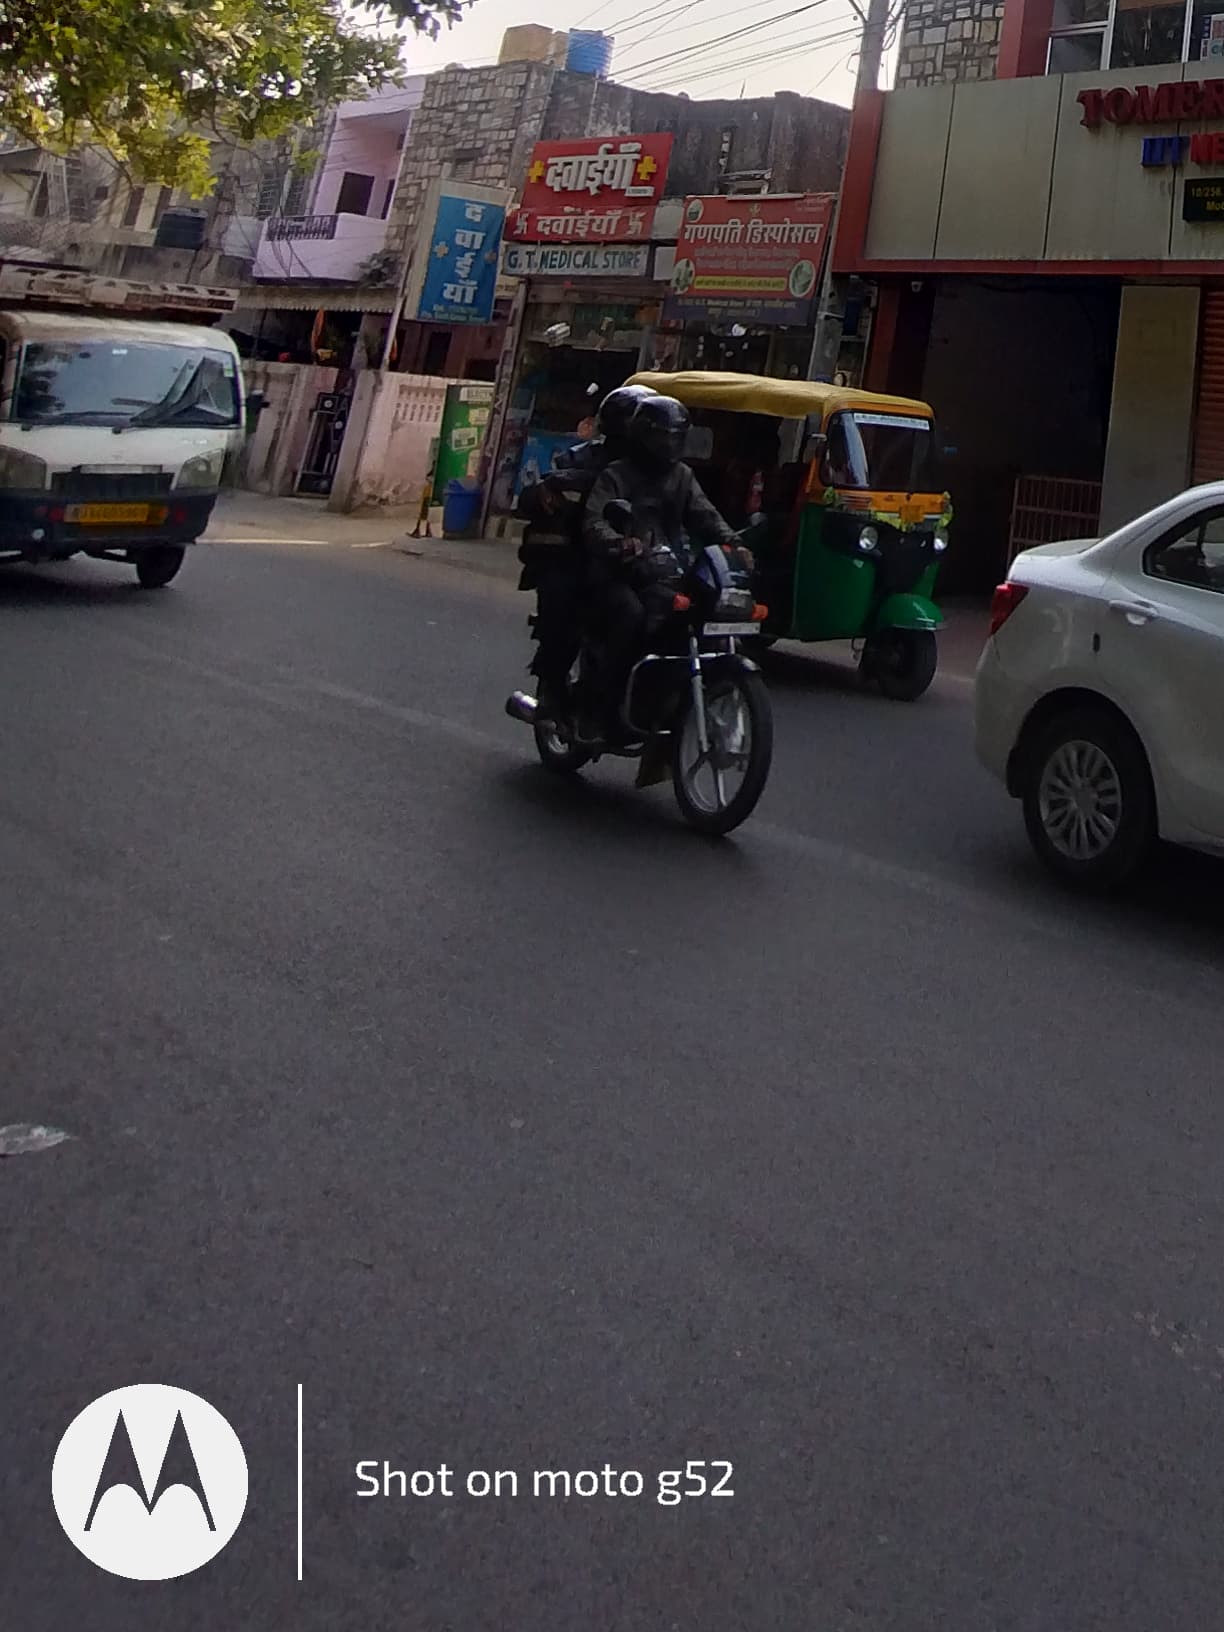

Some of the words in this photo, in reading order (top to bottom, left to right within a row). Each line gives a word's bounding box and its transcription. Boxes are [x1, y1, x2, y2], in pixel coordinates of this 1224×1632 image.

[684, 218, 745, 244] गणपति
[539, 249, 600, 268] MEDICAL
[602, 249, 641, 268] STORE
